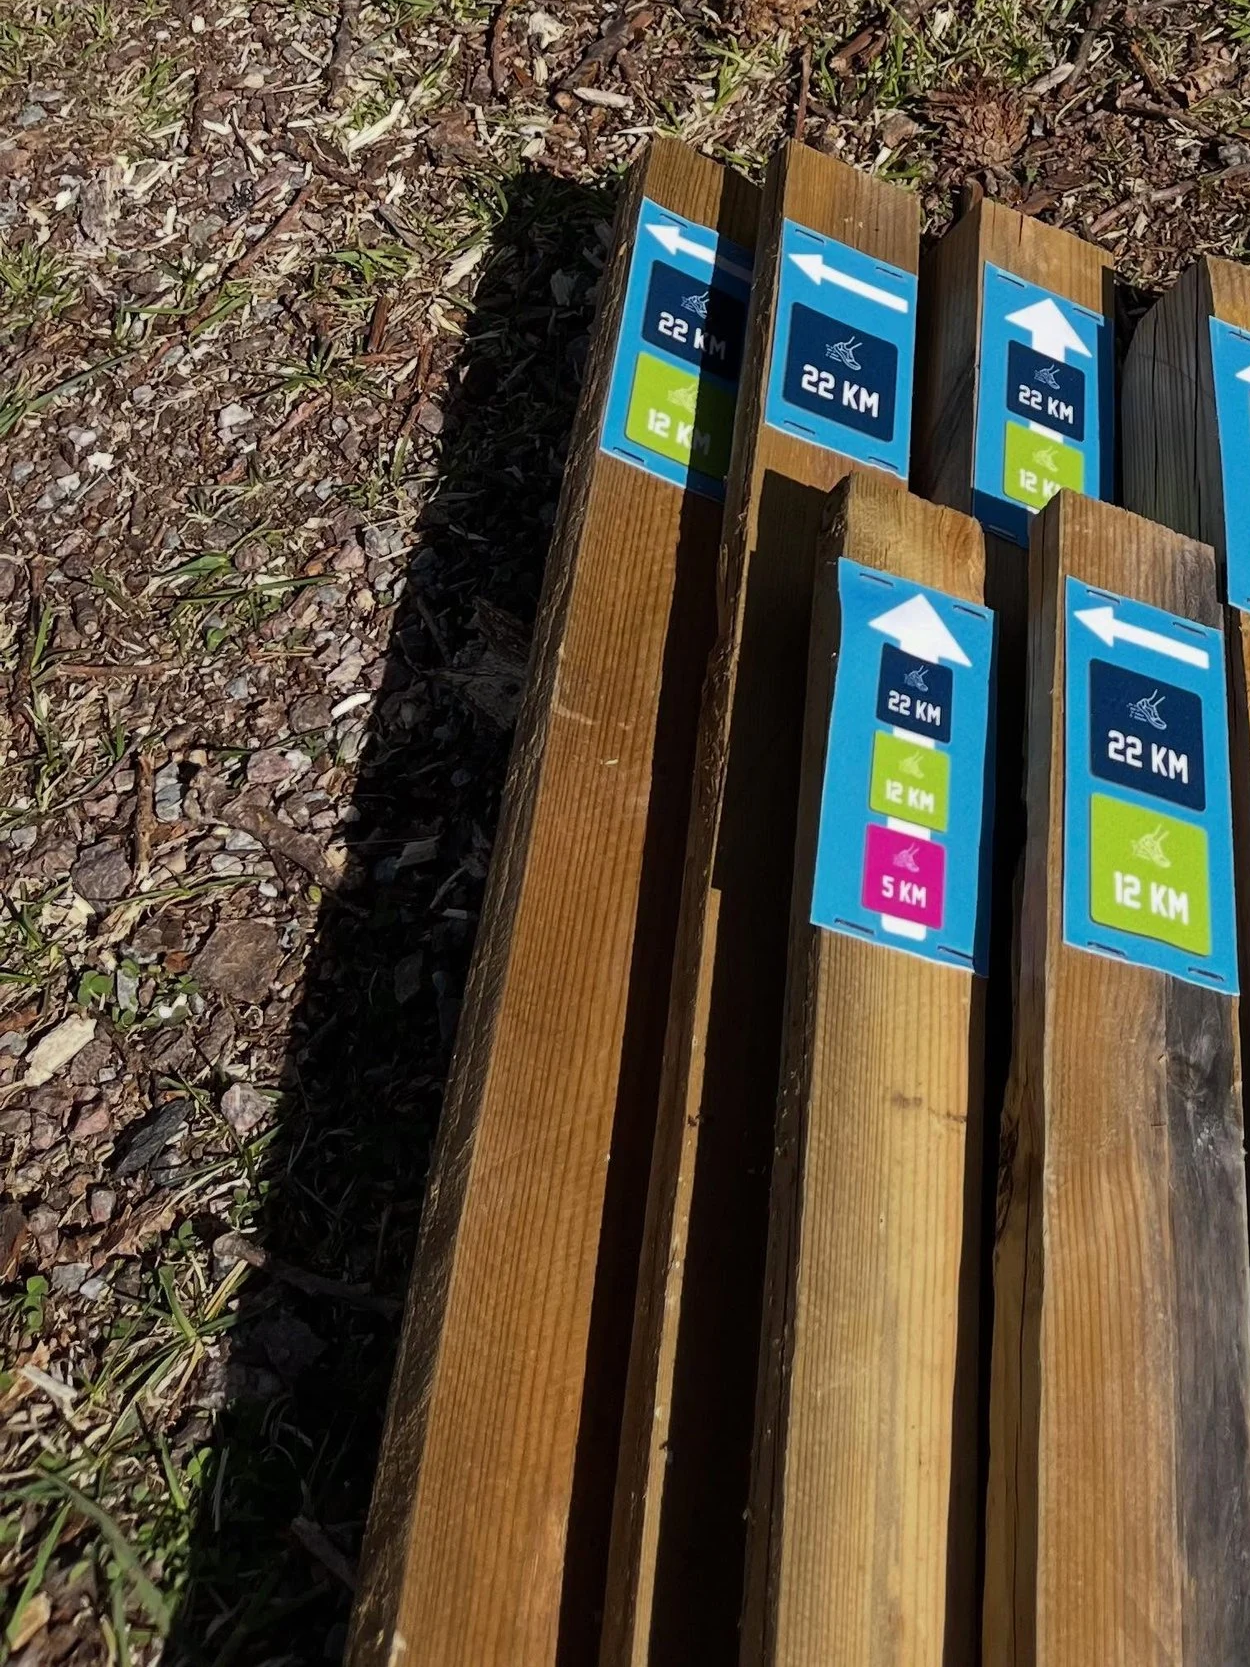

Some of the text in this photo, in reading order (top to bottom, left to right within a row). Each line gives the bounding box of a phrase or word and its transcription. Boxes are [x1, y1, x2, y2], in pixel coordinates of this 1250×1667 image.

[658, 312, 726, 360] 22 KM
[801, 363, 880, 418] 22 KM
[1019, 384, 1074, 424] 22 KM
[647, 408, 710, 455] 12 KM
[1020, 468, 1038, 493] 12
[888, 690, 941, 726] 22 KM
[1108, 729, 1189, 784] 22 KM
[885, 780, 934, 813] 12 KM
[882, 875, 927, 908] 5 KM
[1113, 870, 1189, 926] 12 KM
